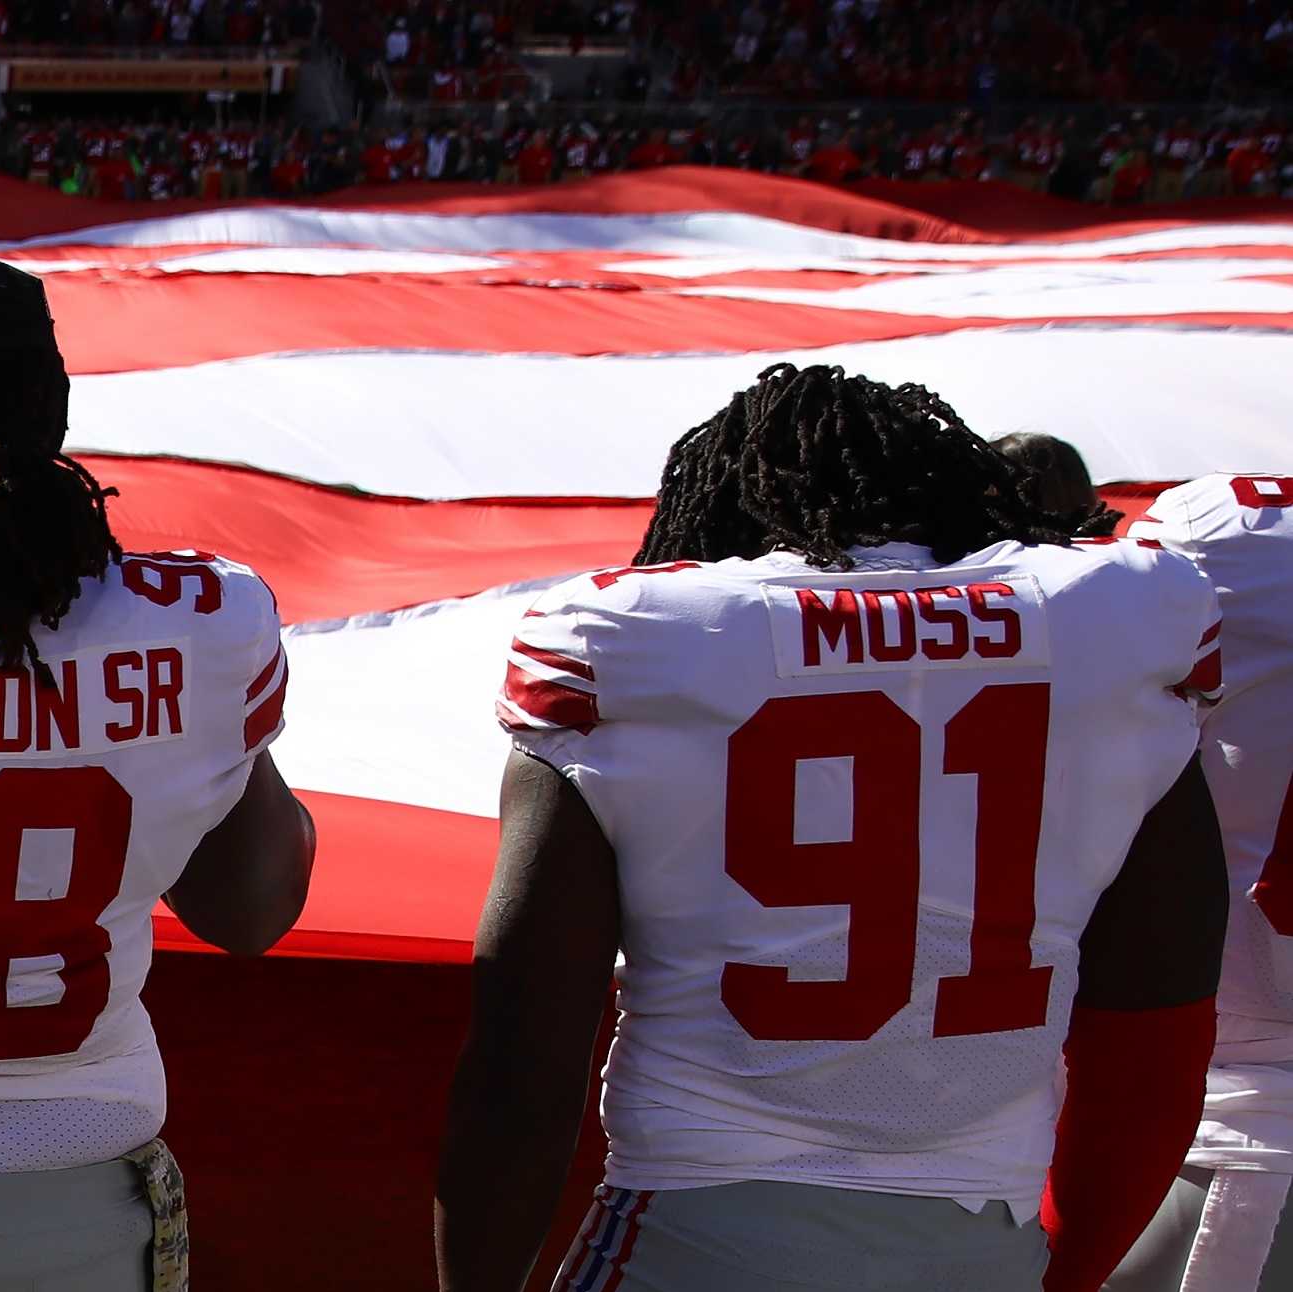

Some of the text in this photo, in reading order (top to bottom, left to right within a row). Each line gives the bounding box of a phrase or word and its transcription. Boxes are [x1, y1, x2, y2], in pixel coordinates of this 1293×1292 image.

[794, 581, 1021, 667] MOSS
[103, 647, 184, 743] SR
[721, 682, 1054, 1042] 91
